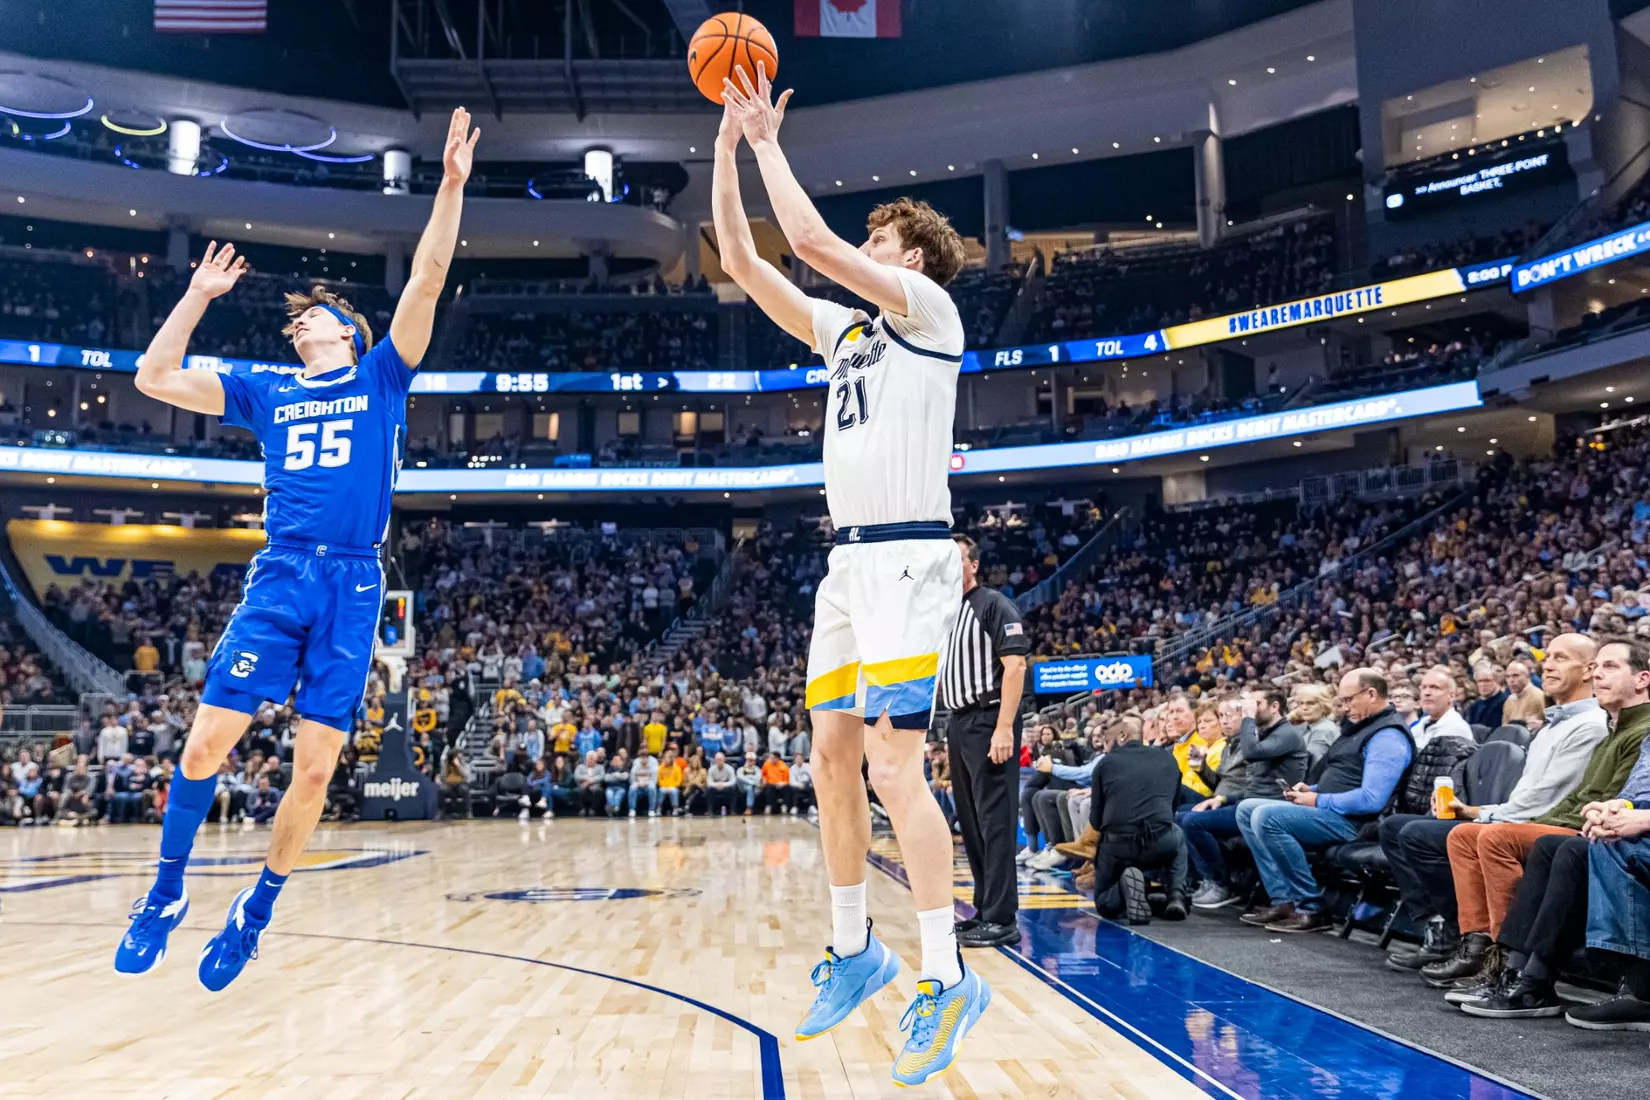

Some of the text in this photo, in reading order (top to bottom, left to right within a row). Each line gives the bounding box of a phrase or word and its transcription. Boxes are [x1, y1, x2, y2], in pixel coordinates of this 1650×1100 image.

[1518, 254, 1572, 286] DON'T
[1573, 233, 1637, 267] WRECK
[1229, 287, 1383, 333] #WEAREMARQUETTE
[28, 345, 113, 368] 1 TOL
[995, 334, 1157, 366] FLS 1 TOL 4
[496, 373, 549, 392] 9:55
[611, 373, 643, 390] 1st
[274, 395, 368, 424] CREIGHTON
[836, 376, 869, 431] 21
[283, 419, 353, 470] 55
[364, 778, 419, 800] meijer
